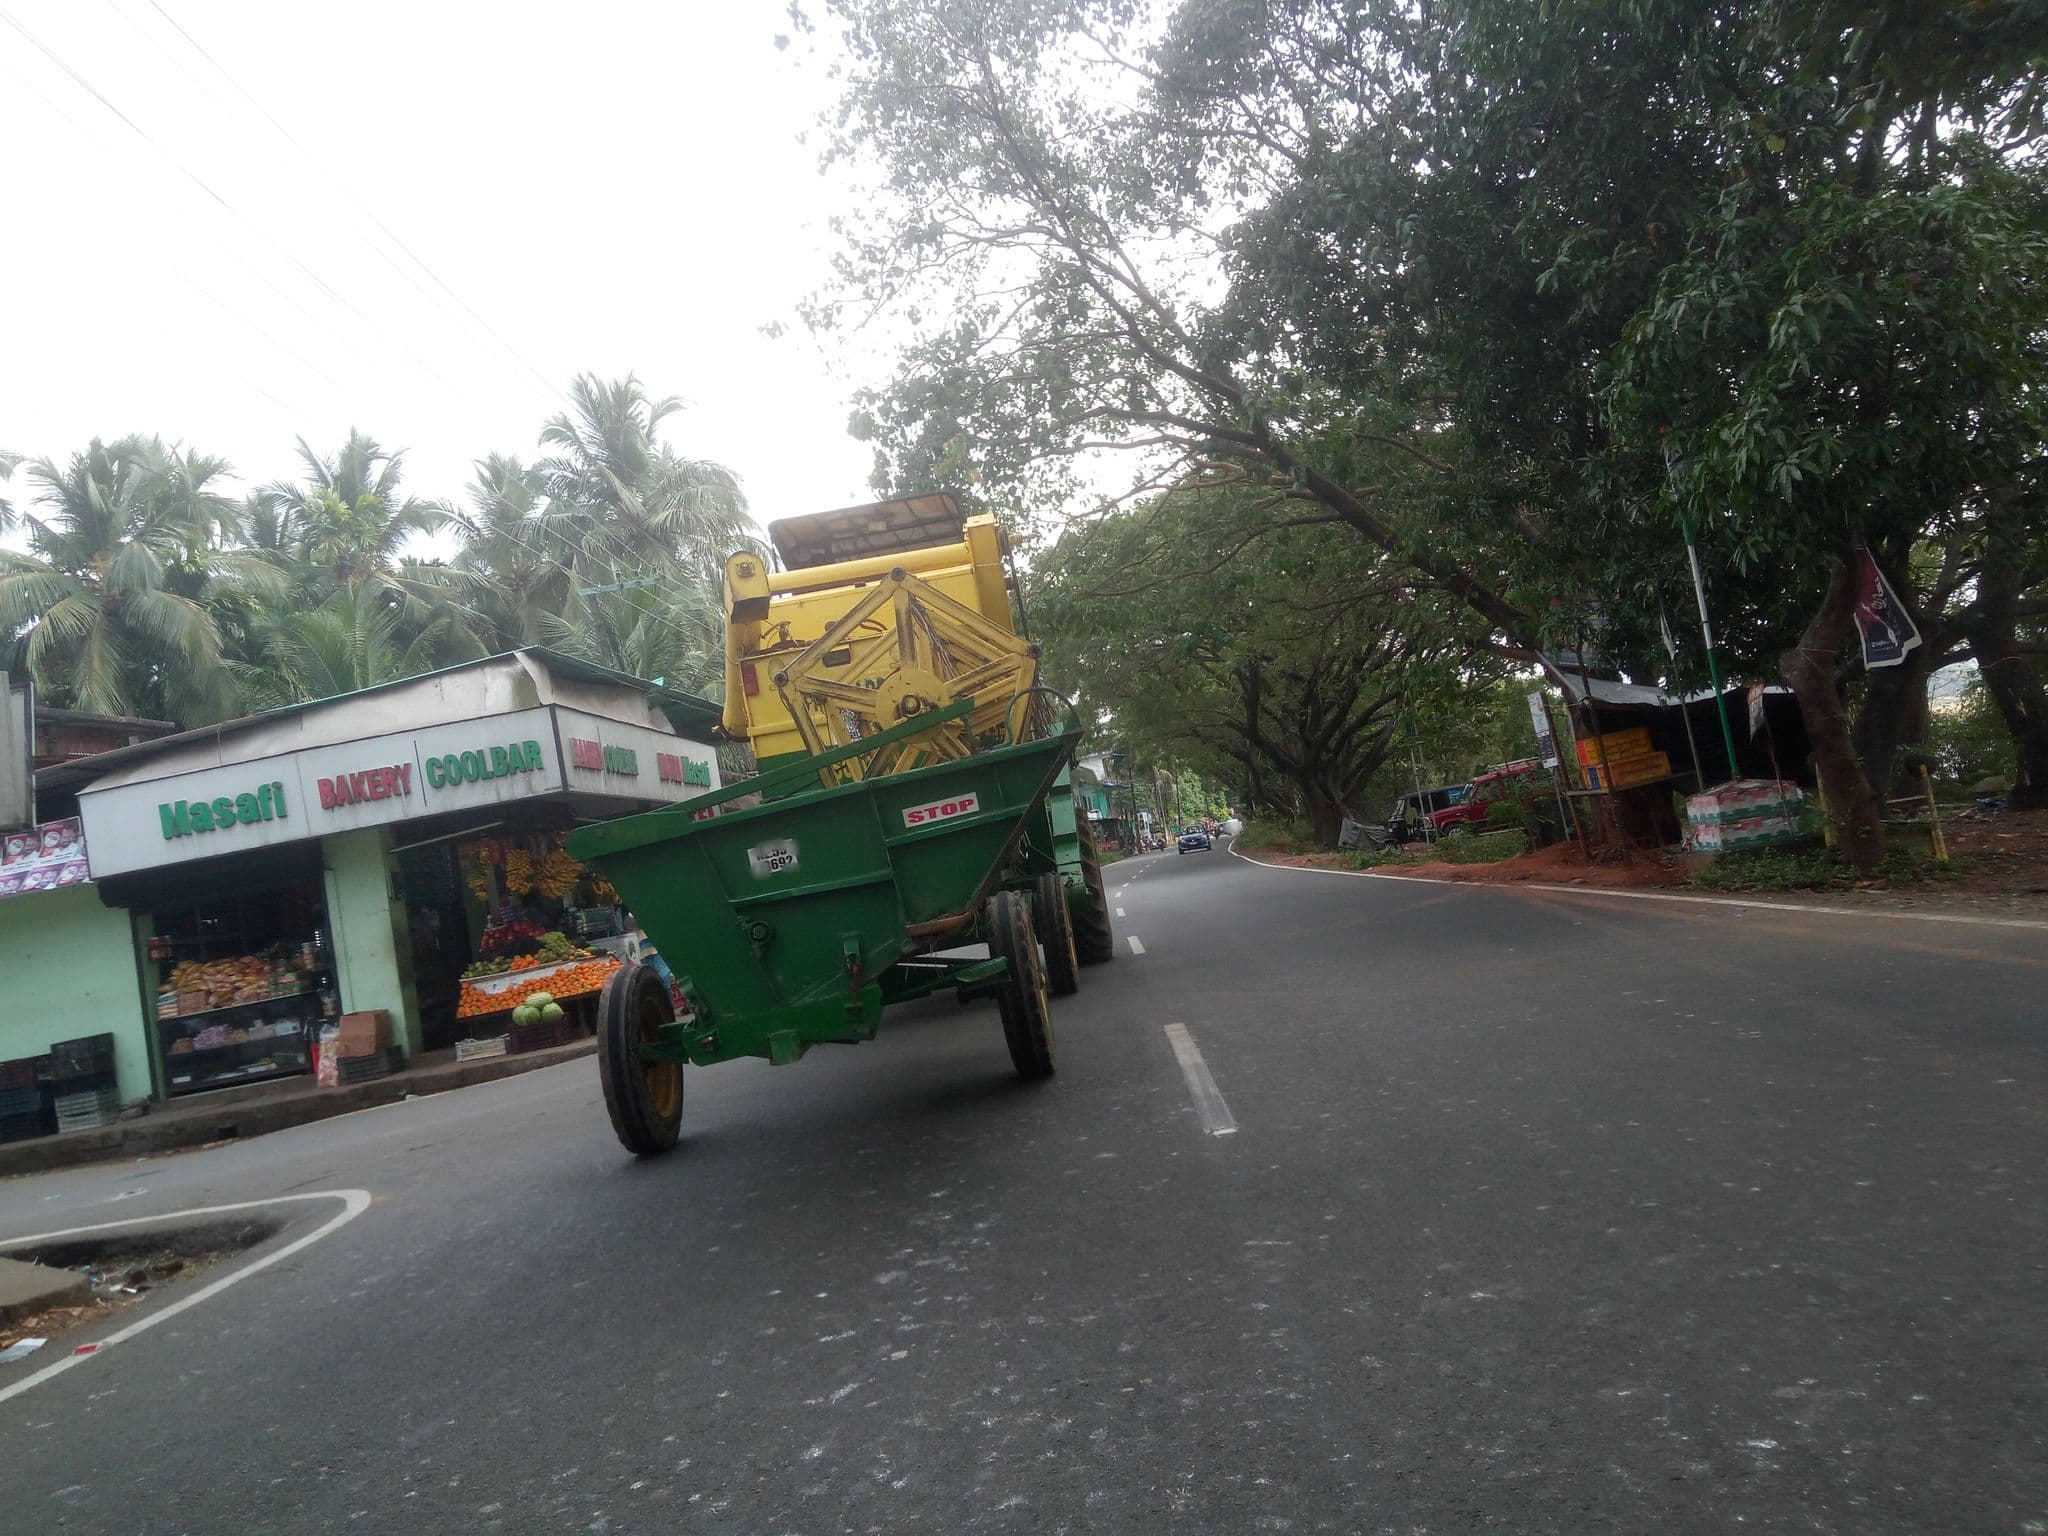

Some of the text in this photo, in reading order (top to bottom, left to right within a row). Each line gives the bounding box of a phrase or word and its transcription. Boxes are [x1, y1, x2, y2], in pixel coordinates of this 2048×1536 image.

[158, 740, 544, 840] Masafi BAKERY COOLBAR
[907, 799, 974, 823] STOP
